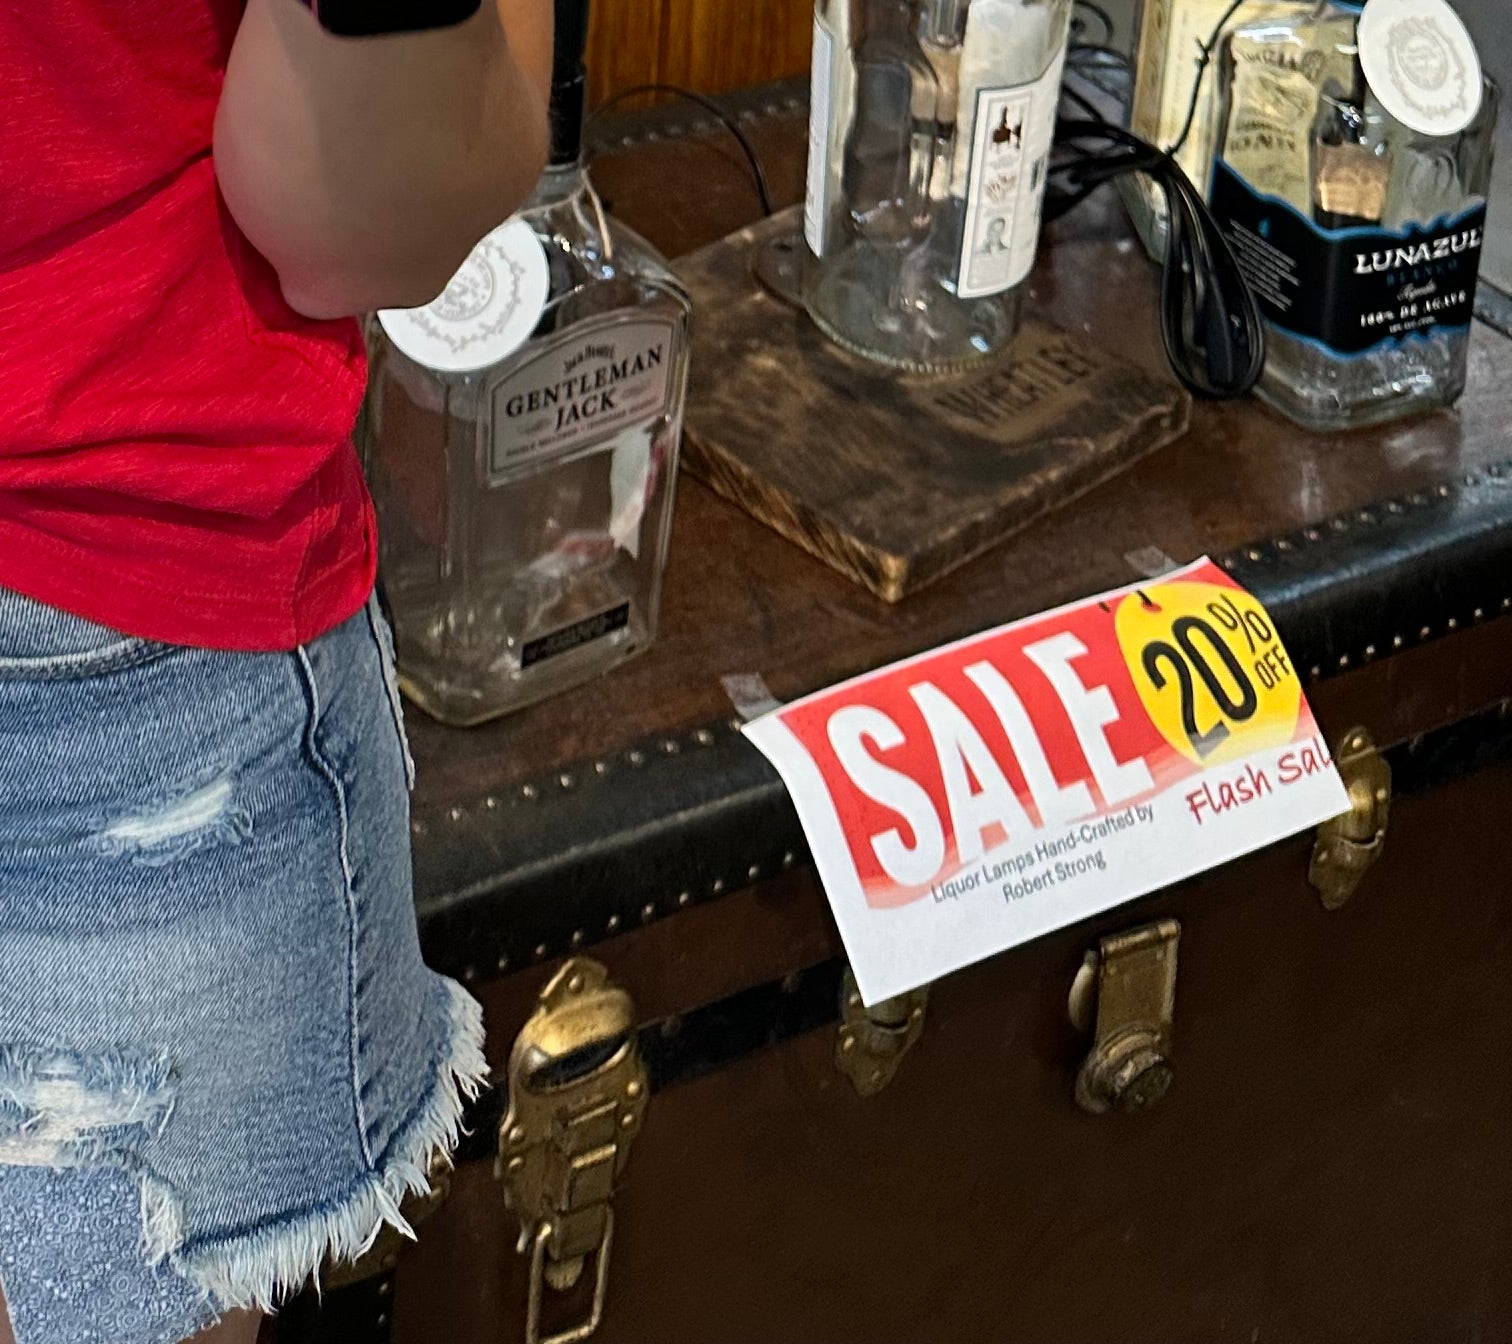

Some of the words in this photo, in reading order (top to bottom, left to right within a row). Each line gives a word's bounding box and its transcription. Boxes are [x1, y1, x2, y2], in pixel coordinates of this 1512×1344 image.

[1353, 228, 1480, 275] LUNAZUL
[505, 343, 664, 418] GENTLEMAN
[554, 388, 617, 432] JACK
[1140, 592, 1272, 759] 20%
[1254, 643, 1290, 690] OFF
[826, 631, 1155, 887] SALE
[1185, 763, 1274, 825] Flash
[1277, 736, 1332, 785] Sal
[930, 872, 981, 903] Liquor
[981, 852, 1036, 884] Lamps
[1034, 809, 1135, 864] Hand-Crafted
[1136, 803, 1153, 824] by
[1001, 868, 1056, 904] Robert
[1055, 849, 1107, 883] Strong
